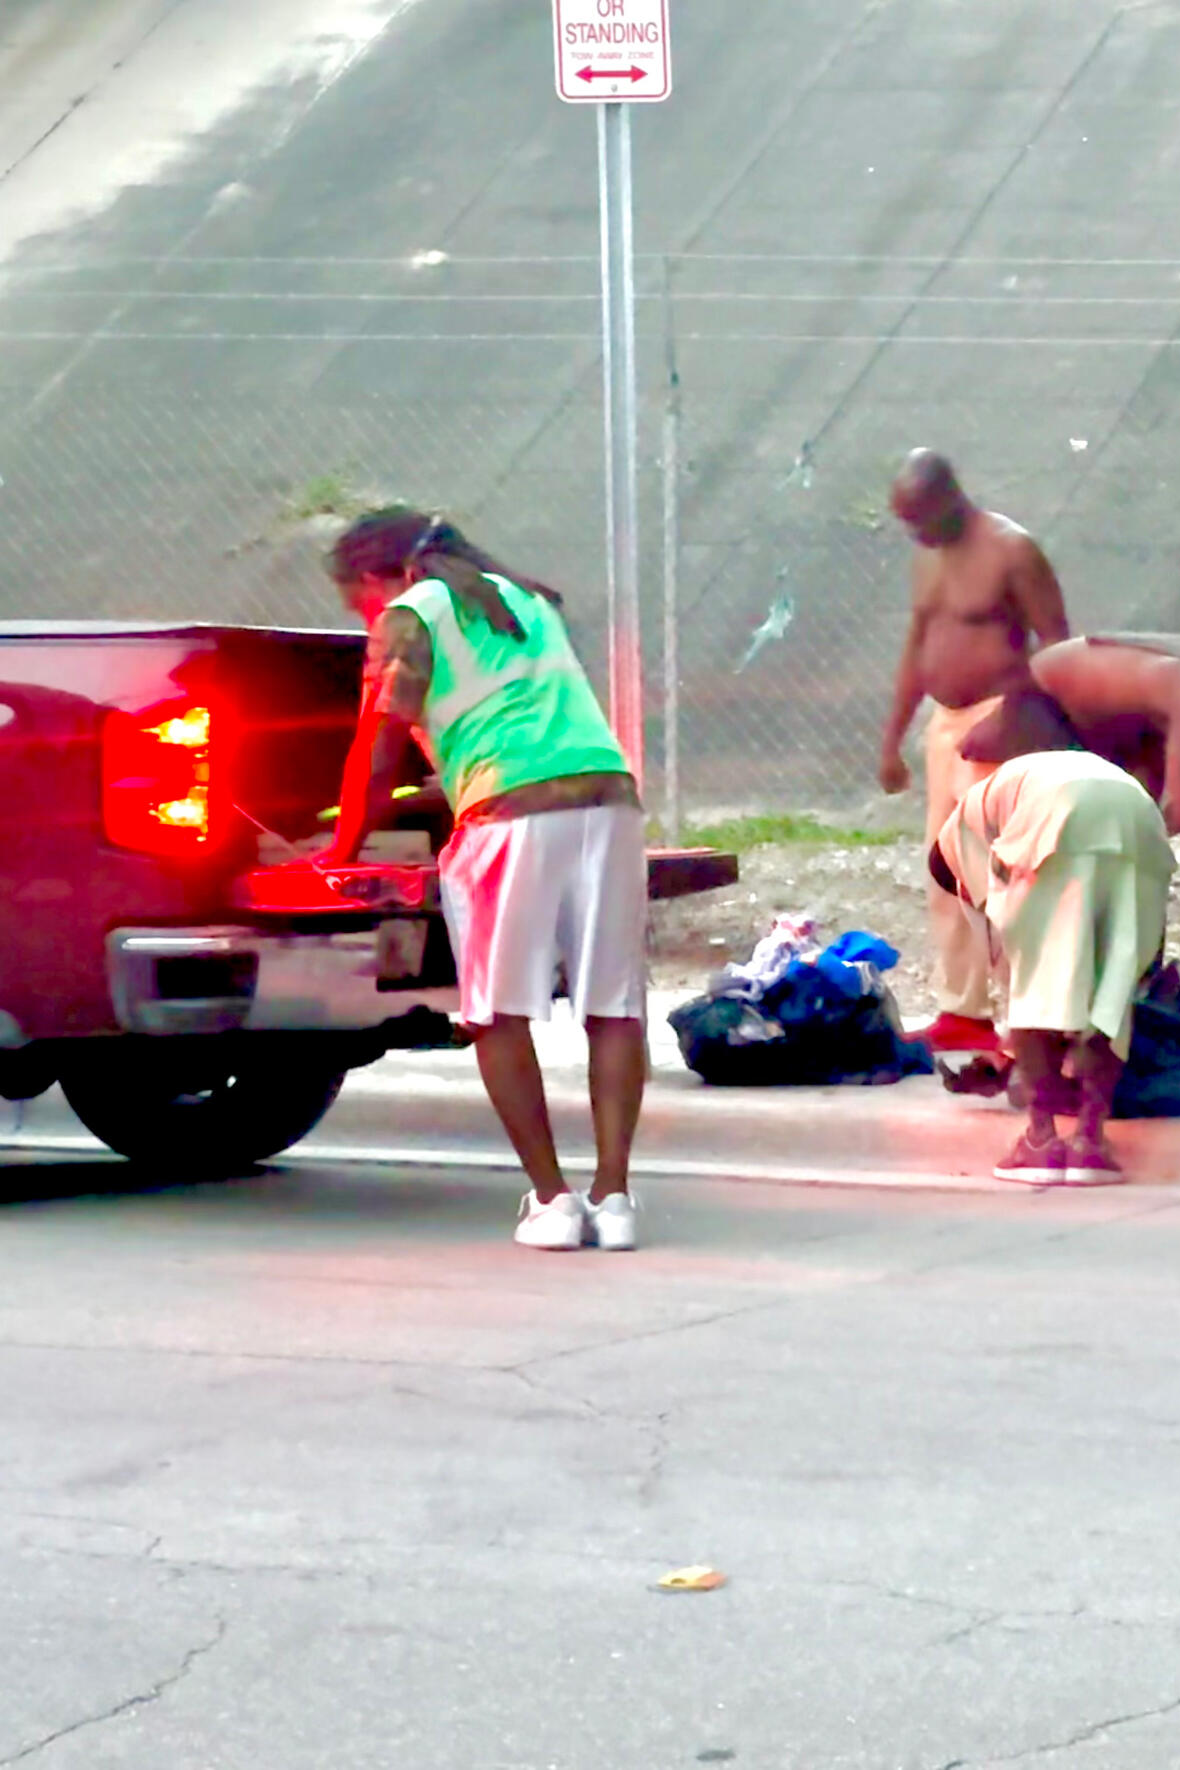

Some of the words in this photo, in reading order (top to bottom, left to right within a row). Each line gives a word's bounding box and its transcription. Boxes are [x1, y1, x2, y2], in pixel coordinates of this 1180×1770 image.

[597, 0, 625, 17] OR
[565, 22, 659, 45] STANDING
[570, 52, 594, 60] TOW
[628, 51, 655, 60] ZONE
